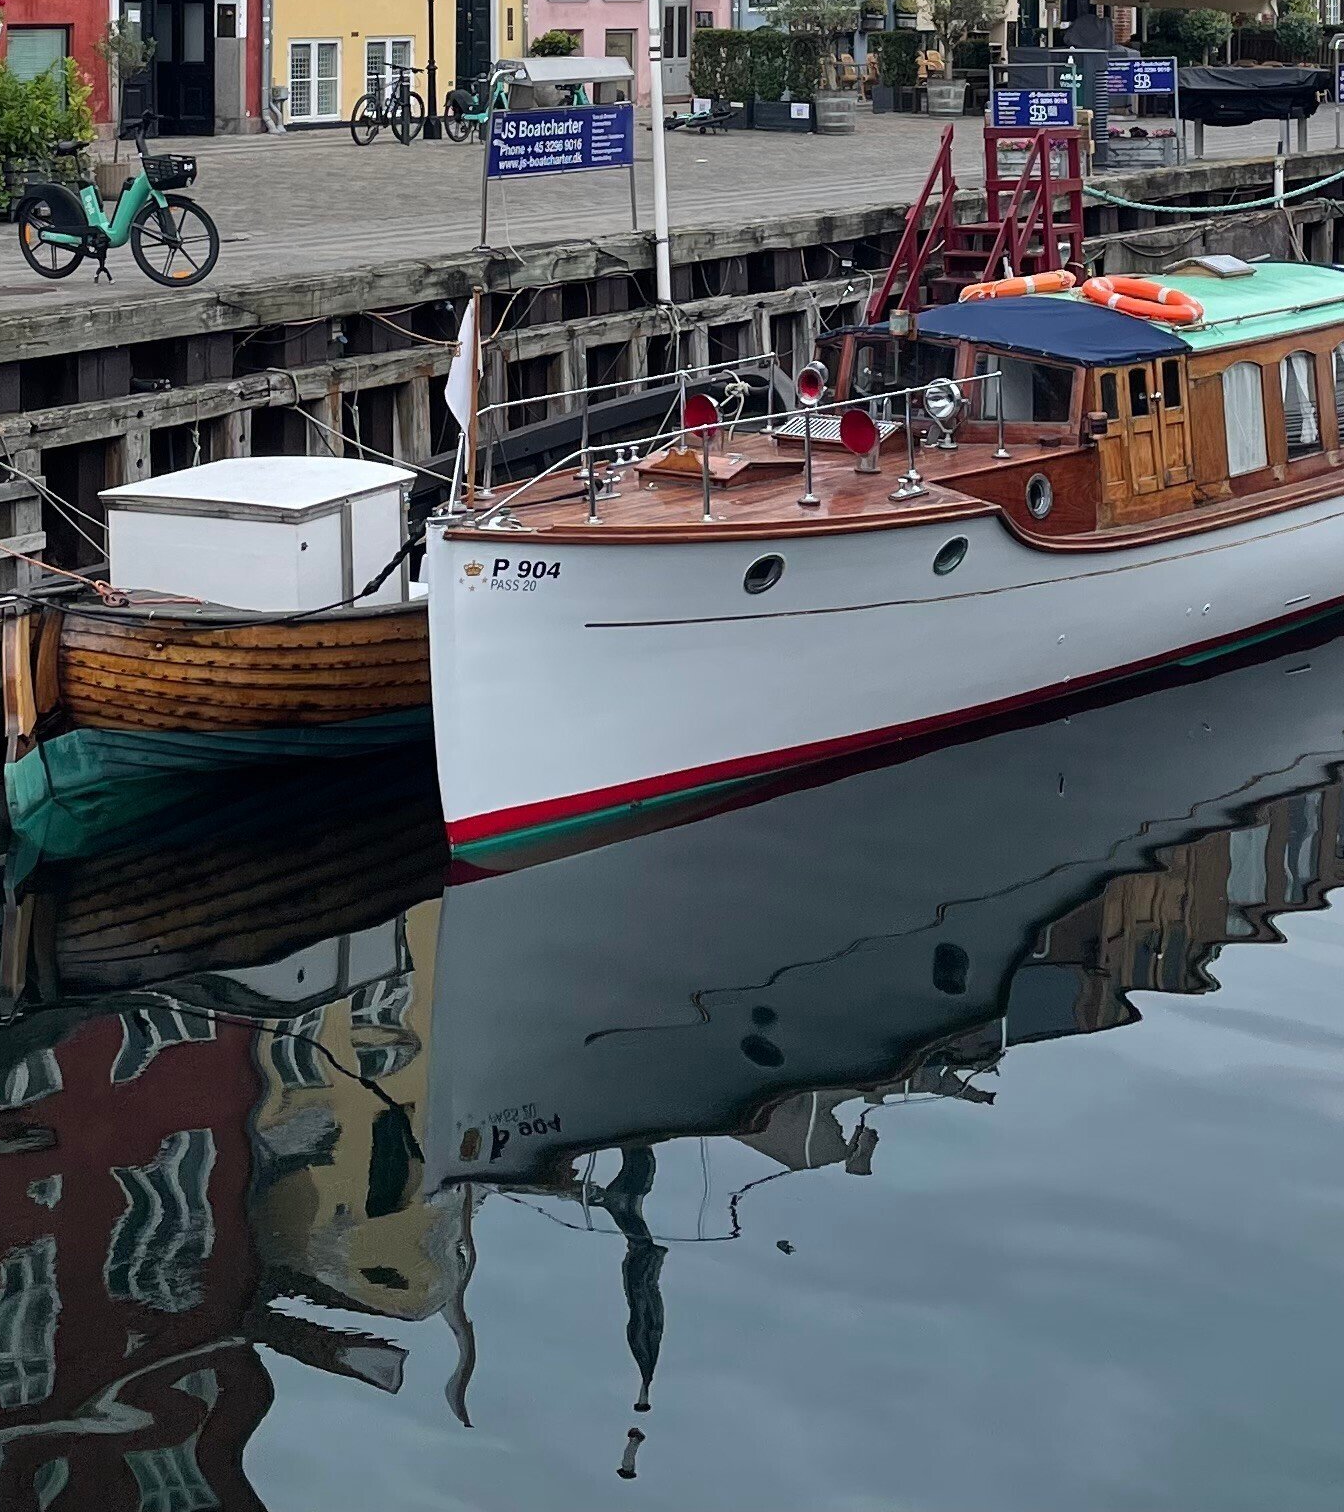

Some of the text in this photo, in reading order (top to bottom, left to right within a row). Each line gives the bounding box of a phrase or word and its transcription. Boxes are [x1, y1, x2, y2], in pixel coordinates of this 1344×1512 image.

[501, 118, 584, 139] JS Boatcharter
[500, 143, 526, 156] Phone
[534, 141, 544, 153] 45
[492, 558, 561, 579] P 904
[490, 578, 537, 591] PASS 20
